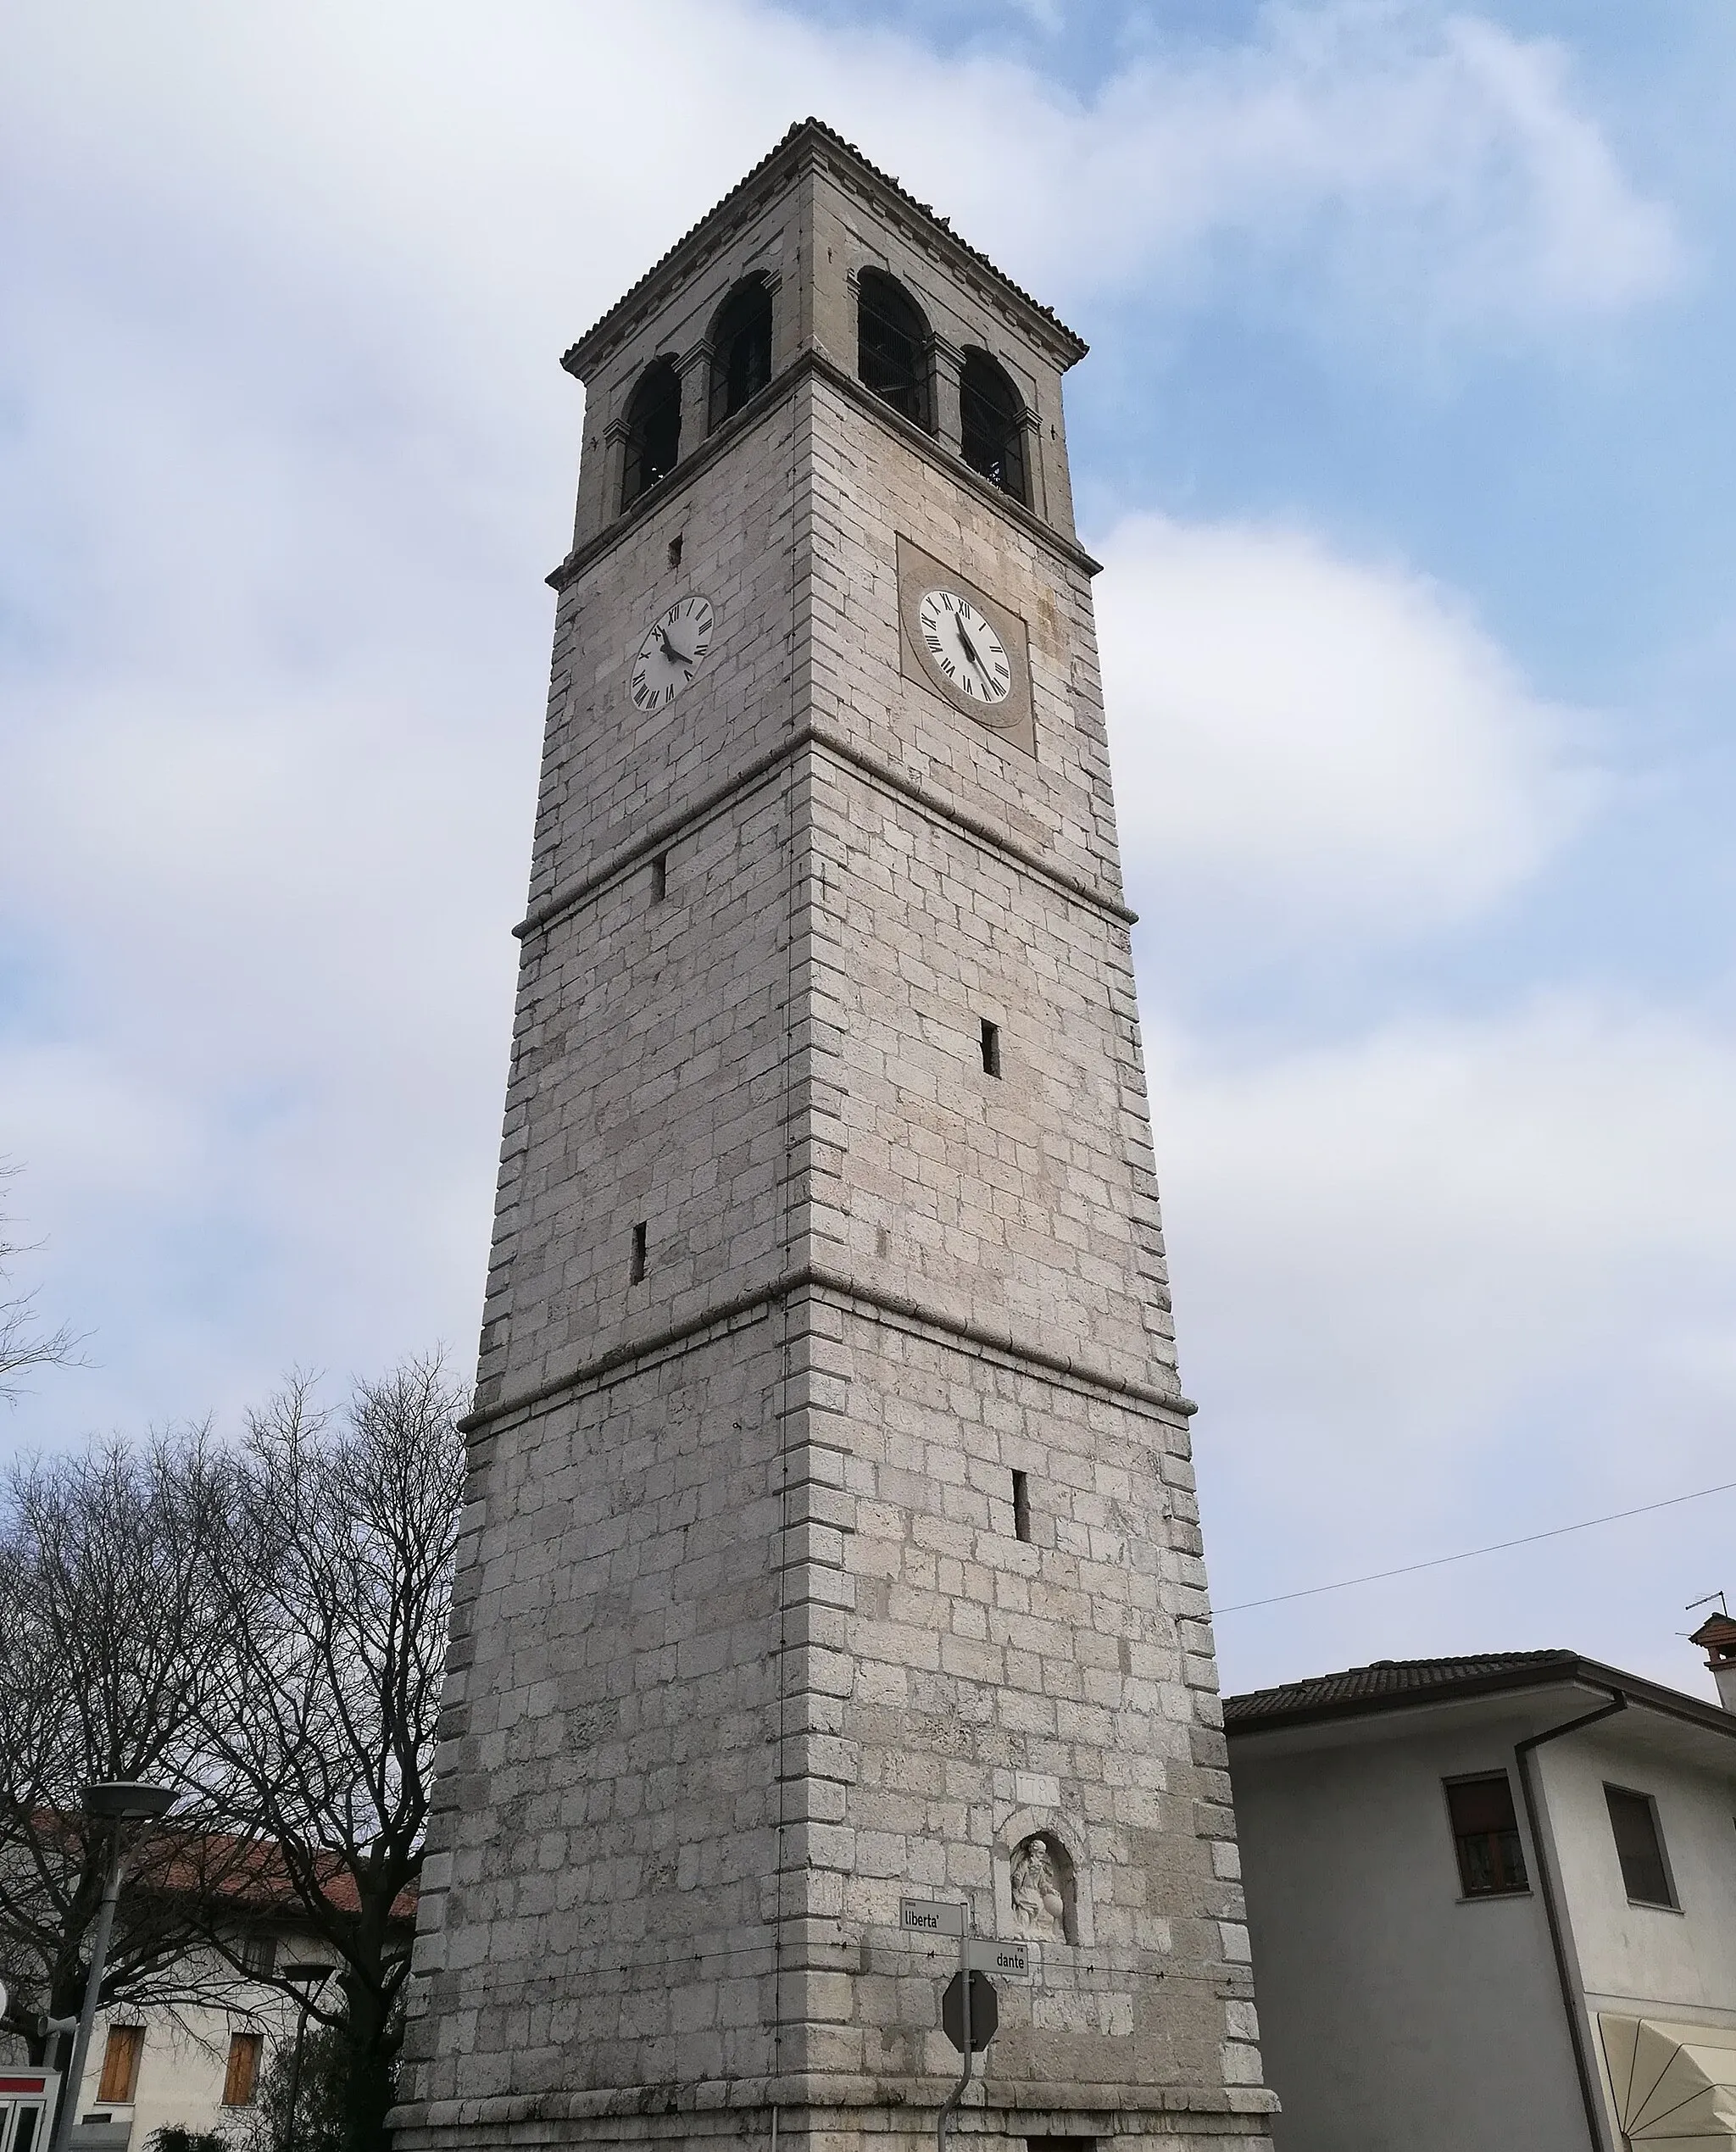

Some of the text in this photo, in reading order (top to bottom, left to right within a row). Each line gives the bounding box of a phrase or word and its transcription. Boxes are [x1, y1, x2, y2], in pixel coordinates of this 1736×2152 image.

[687, 598, 695, 617] I
[926, 597, 941, 615] X
[939, 592, 954, 611] XI
[958, 598, 971, 620] XII
[668, 604, 680, 626] XII
[695, 603, 709, 621] II
[698, 618, 713, 636] III
[921, 613, 937, 631] IX
[978, 622, 987, 631] I
[694, 644, 709, 655] IV
[925, 635, 943, 653] VIII
[638, 652, 652, 660] X
[683, 670, 693, 681] V
[940, 657, 956, 678] VII
[994, 662, 1010, 679] III
[632, 670, 646, 688] IX
[962, 675, 973, 695] VI
[646, 690, 659, 709] VII
[665, 683, 674, 703] VI
[981, 683, 992, 702] V
[905, 1910, 939, 1928] liberta'
[997, 1953, 1024, 1968] dante
